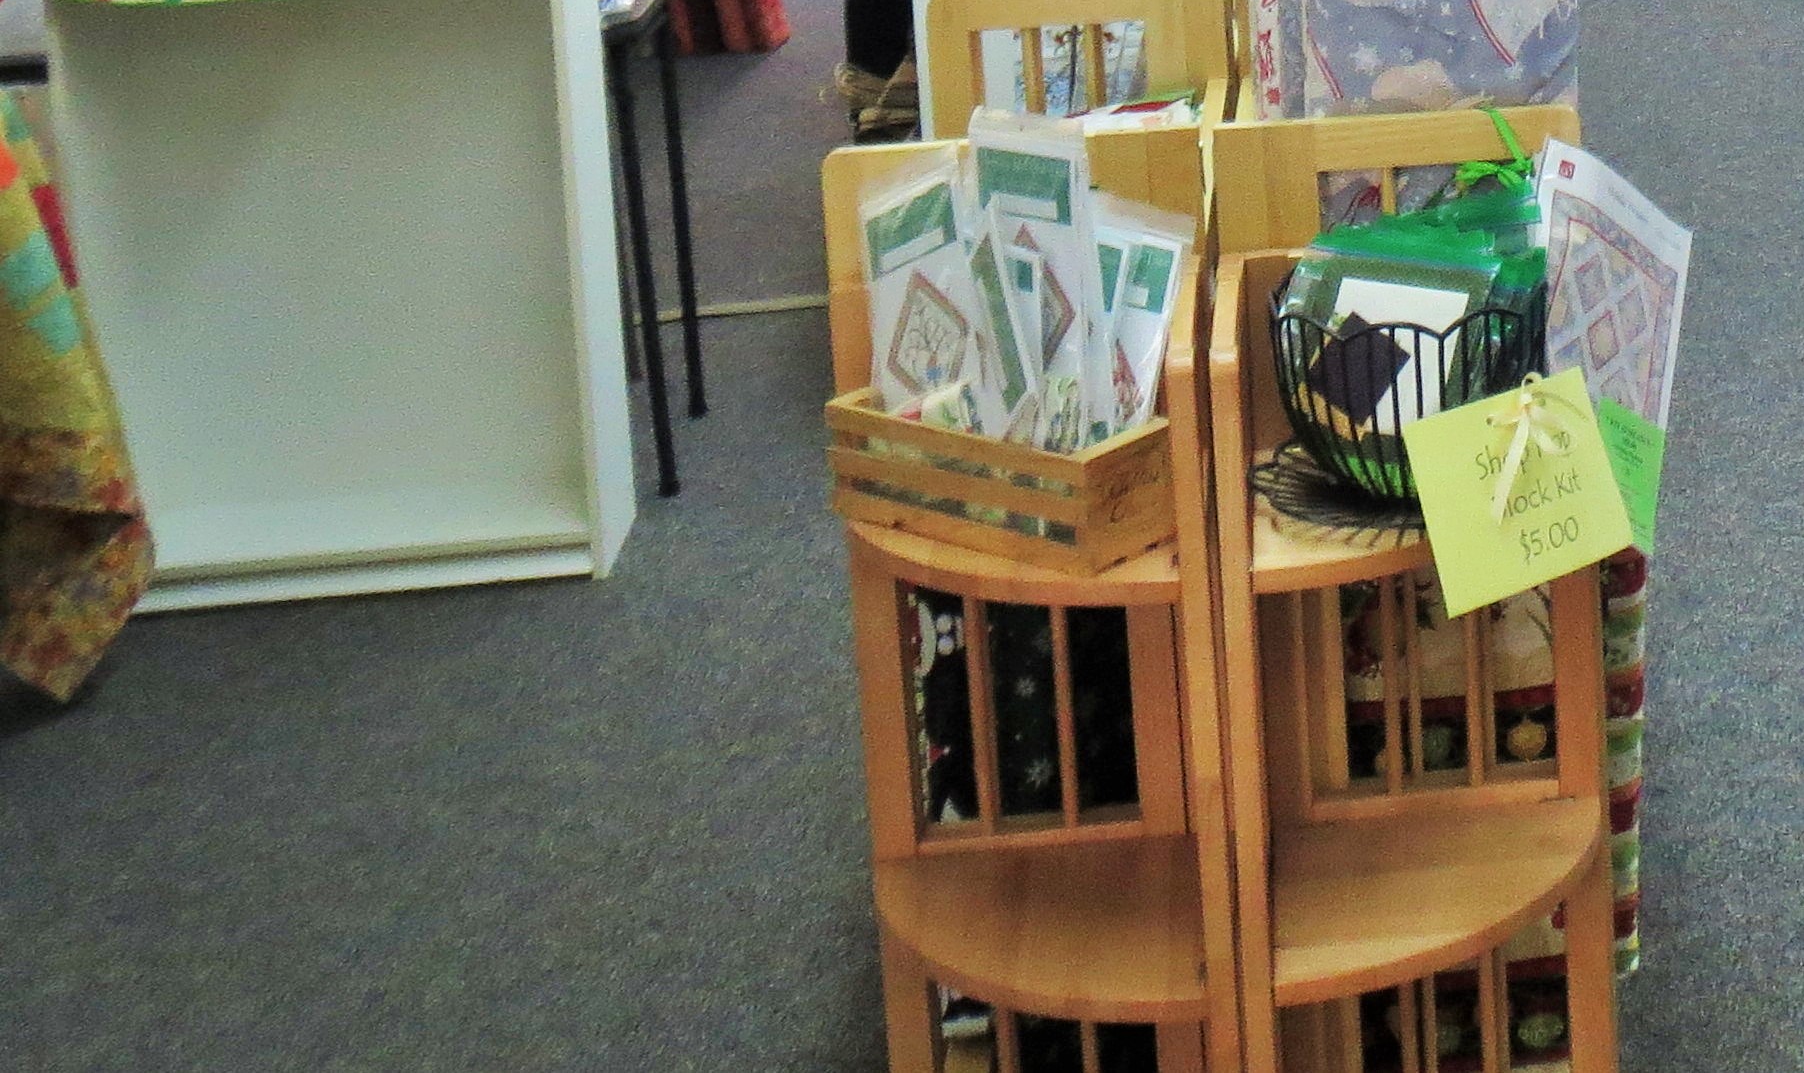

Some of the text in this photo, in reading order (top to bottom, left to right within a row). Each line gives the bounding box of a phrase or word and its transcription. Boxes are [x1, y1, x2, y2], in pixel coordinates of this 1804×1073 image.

[1491, 467, 1582, 518] lock Kit
[1520, 516, 1579, 566] $5.00
